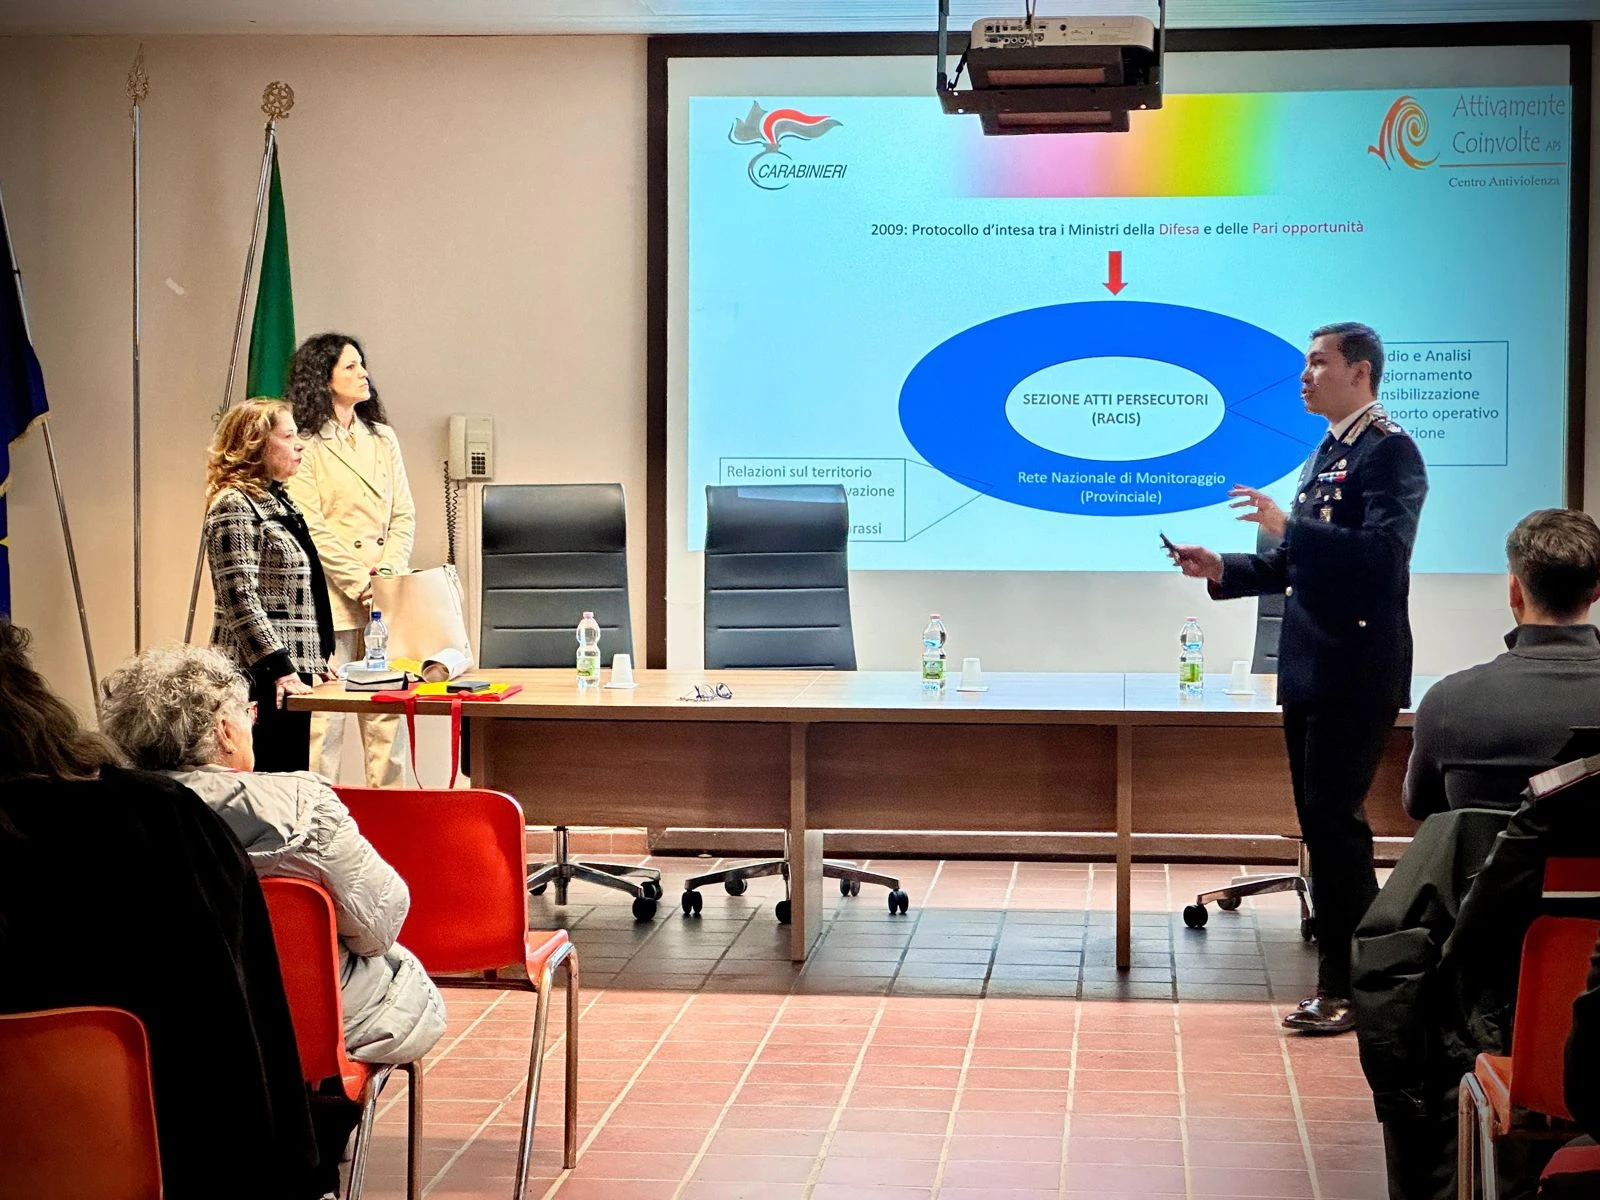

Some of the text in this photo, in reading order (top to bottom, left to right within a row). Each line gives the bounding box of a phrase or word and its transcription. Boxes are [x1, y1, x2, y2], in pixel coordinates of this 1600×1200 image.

[1452, 92, 1566, 118] Attivamente
[1452, 125, 1561, 154] Coinvolte APS
[758, 163, 848, 179] CARABINIERI
[1448, 175, 1560, 188] Centro Antiviolenza
[871, 223, 908, 236] 2009:
[912, 223, 979, 236] Protocollo
[1038, 224, 1057, 236] tra
[1068, 223, 1120, 236] Ministri
[1123, 222, 1155, 236] della
[1159, 222, 1200, 235] Difesa
[1203, 225, 1212, 235] e
[1215, 222, 1249, 235] delle
[1252, 221, 1278, 234] Pari
[1282, 220, 1365, 236] opportunità
[1413, 352, 1422, 362] e
[1425, 348, 1472, 362] Analisi
[1383, 369, 1473, 384] giornamento
[1023, 393, 1208, 406] SEZIONE ATTI PERSECUTORI
[1381, 387, 1480, 400] nsibilizzazione
[1092, 411, 1141, 427] (RACIS)
[1432, 406, 1500, 422] operativo
[727, 465, 873, 478] Relazioni sul territorio
[1018, 471, 1226, 487] Rete Nazionale di Monitoraggio
[1080, 489, 1162, 505] (Provinciale)
